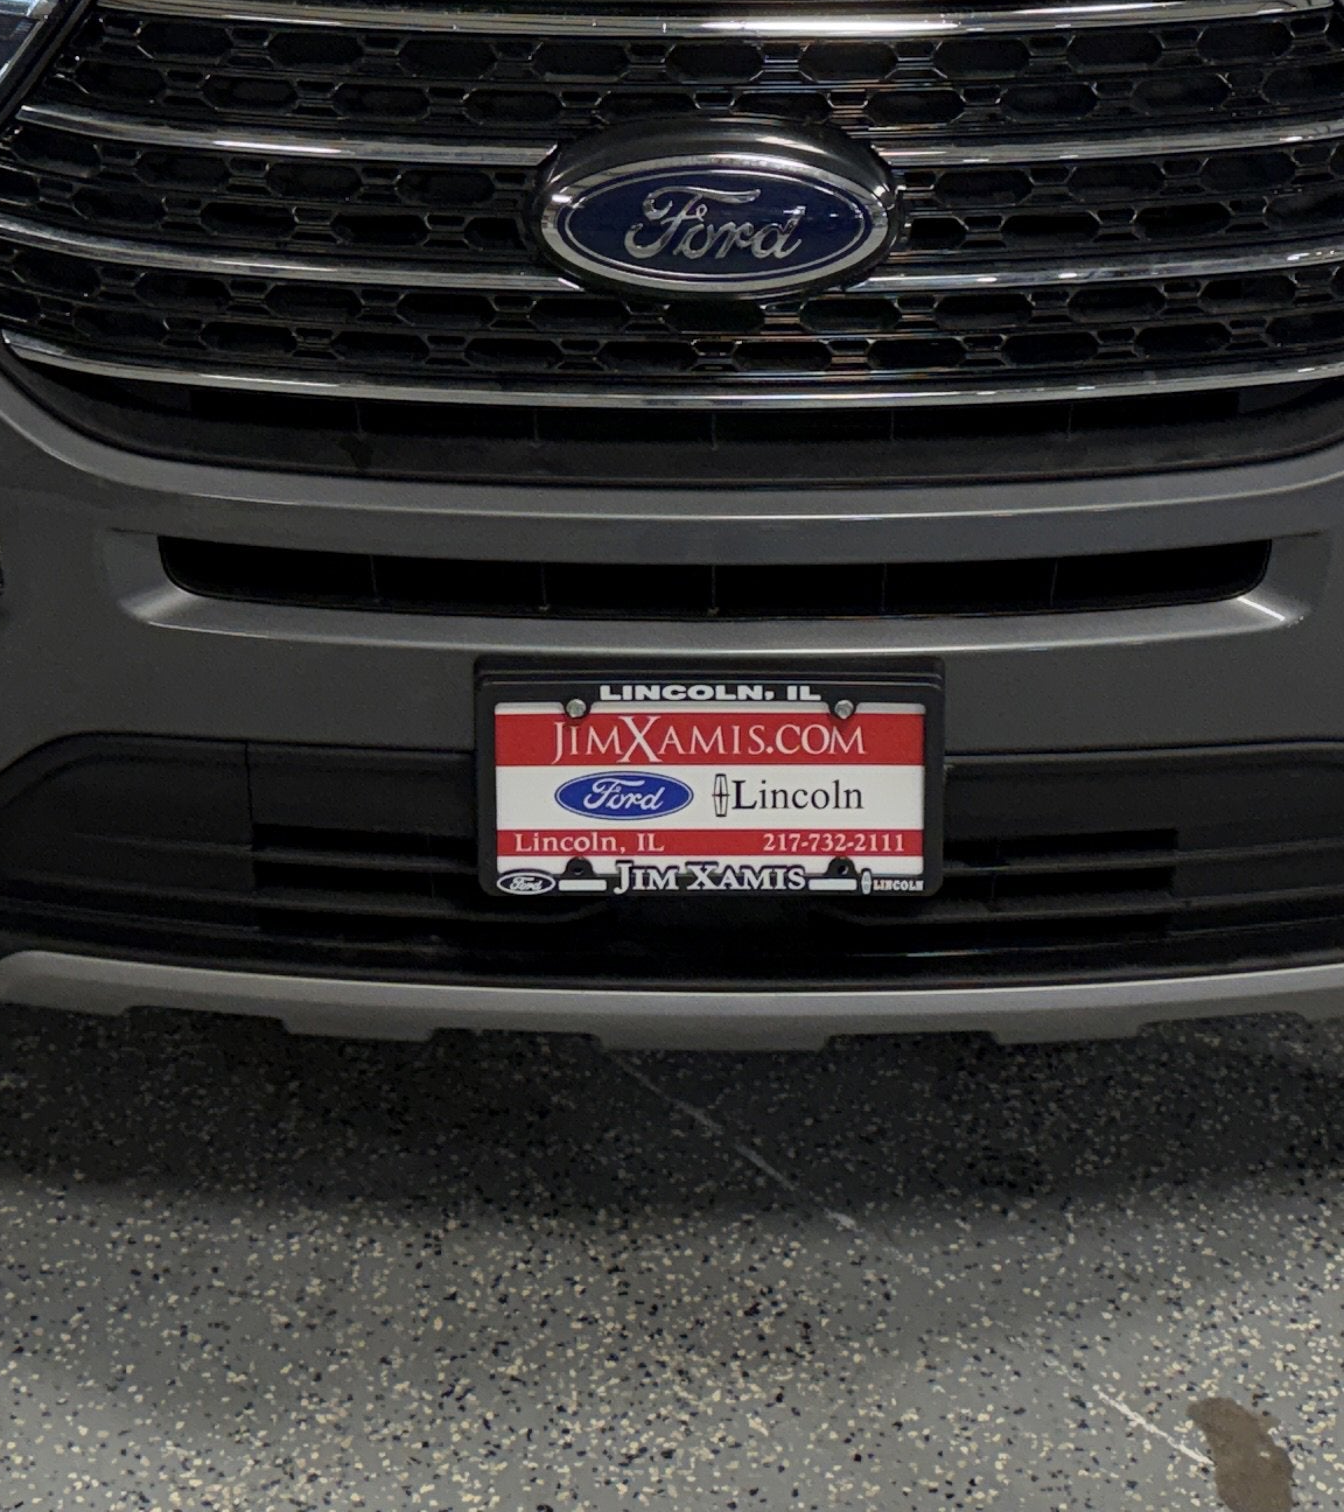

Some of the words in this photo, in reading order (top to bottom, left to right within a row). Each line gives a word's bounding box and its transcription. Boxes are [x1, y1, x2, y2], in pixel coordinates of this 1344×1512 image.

[624, 185, 807, 260] Ford
[600, 684, 774, 702] LINCOLN,
[787, 685, 822, 702] IL
[551, 715, 867, 764] JIMXAMIS.COM
[583, 777, 665, 812] Ford
[731, 780, 865, 809] Lincoln
[514, 833, 626, 854] Lincoln,
[636, 833, 666, 852] IL
[763, 833, 904, 852] 217-732-2111
[613, 860, 679, 895] JIM
[686, 861, 806, 890] XAMIS
[873, 879, 924, 891] LINCOLN
